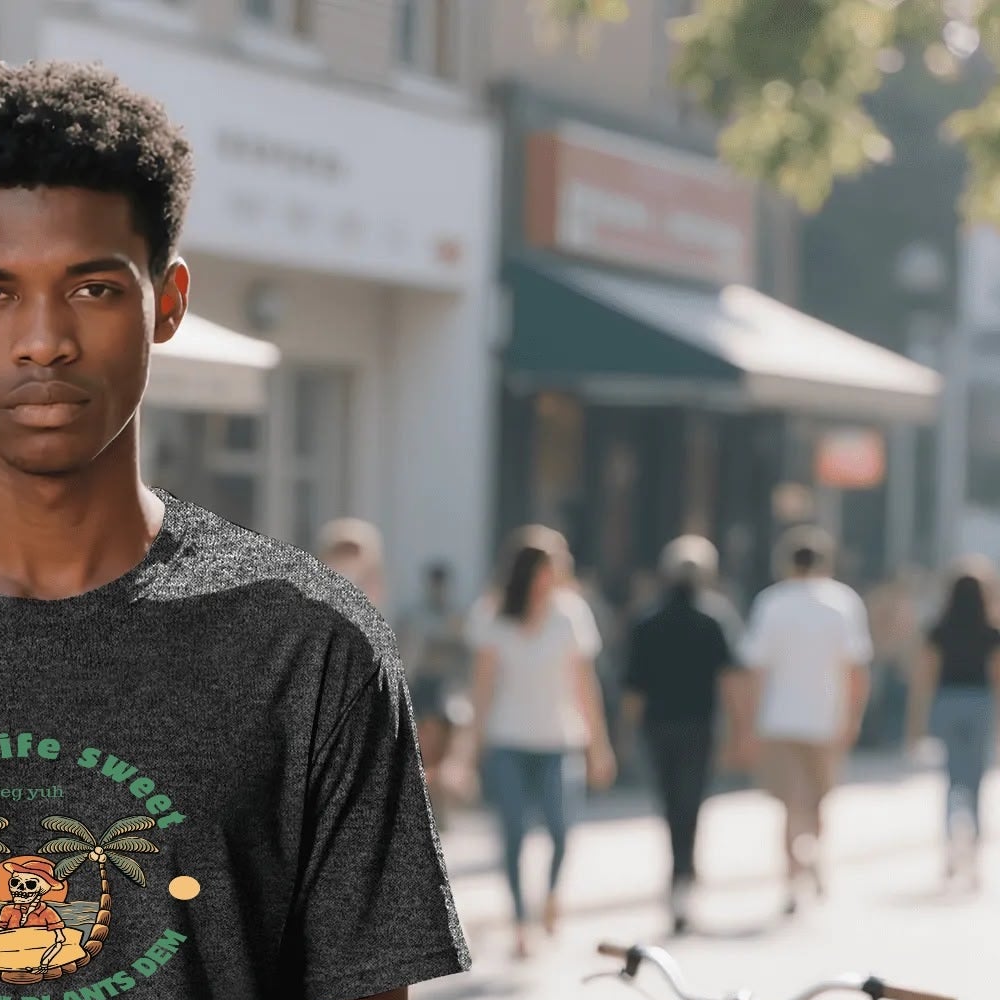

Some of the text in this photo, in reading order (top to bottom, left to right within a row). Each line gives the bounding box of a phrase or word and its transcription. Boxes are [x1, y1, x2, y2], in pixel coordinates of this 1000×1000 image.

[28, 786, 64, 801] yuh
[78, 746, 187, 829] sweet
[131, 928, 188, 978] DEM
